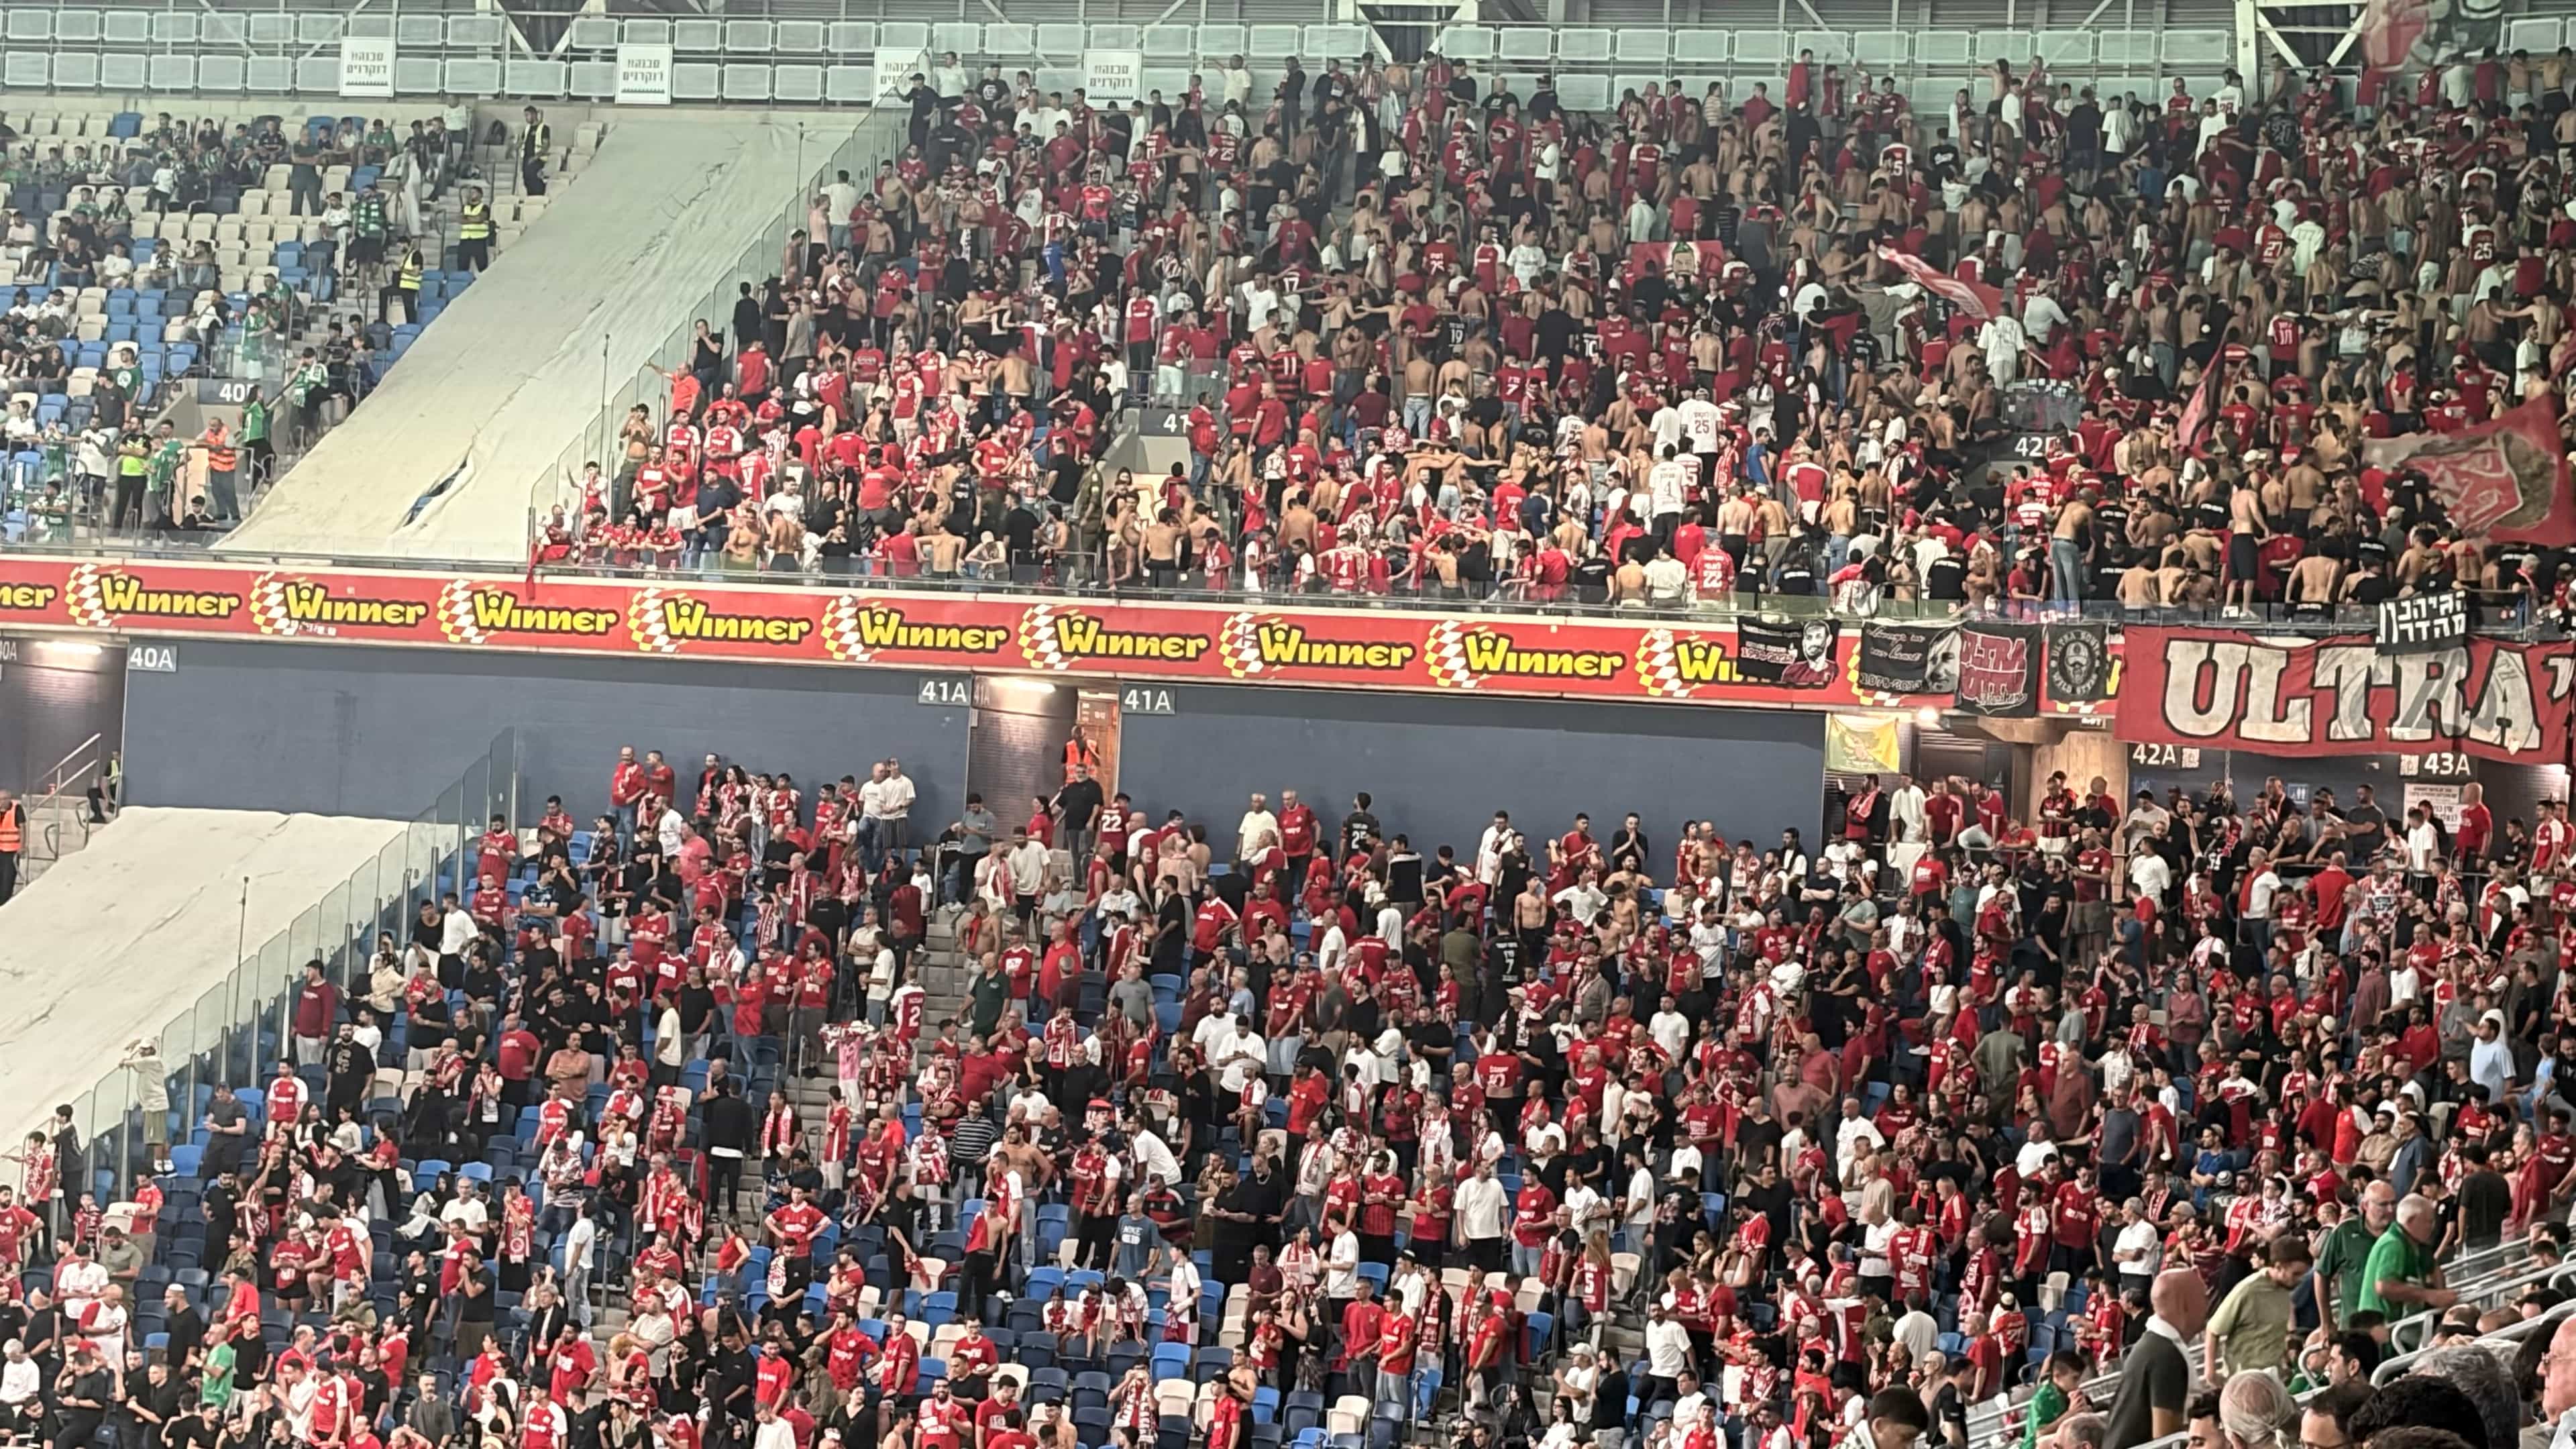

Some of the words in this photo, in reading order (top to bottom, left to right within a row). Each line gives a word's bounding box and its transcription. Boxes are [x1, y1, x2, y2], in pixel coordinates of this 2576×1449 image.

[1220, 147, 1235, 161] 25
[2263, 241, 2282, 257] 27
[2473, 241, 2493, 260] 25
[1283, 277, 1299, 292] 17
[1450, 329, 1464, 343] 19
[1283, 356, 1297, 376] 11
[1772, 362, 1783, 377] 4
[1506, 384, 1519, 396] 7
[1695, 420, 1710, 434] 25
[2234, 419, 2243, 435] 4
[1338, 561, 1349, 578] 4
[1704, 571, 1723, 588] 22
[101, 576, 239, 615] Winner
[284, 582, 428, 625] Winner
[473, 591, 616, 633] Winner
[664, 598, 810, 643] Winner
[859, 610, 1008, 650] Winner
[1057, 614, 1208, 658] Winner
[1258, 625, 1413, 668] Winner
[2051, 631, 2076, 657] ULTRA
[129, 646, 174, 669] 40A
[1465, 633, 1624, 677] Winner
[921, 681, 968, 703] 41A
[1124, 689, 1172, 711] 41A
[2133, 744, 2177, 765] 42A
[2423, 753, 2471, 775] 43A
[1101, 814, 1122, 833] 22
[1506, 958, 1515, 975] 7
[908, 1006, 921, 1027] 2
[1585, 1271, 1595, 1294] 5
